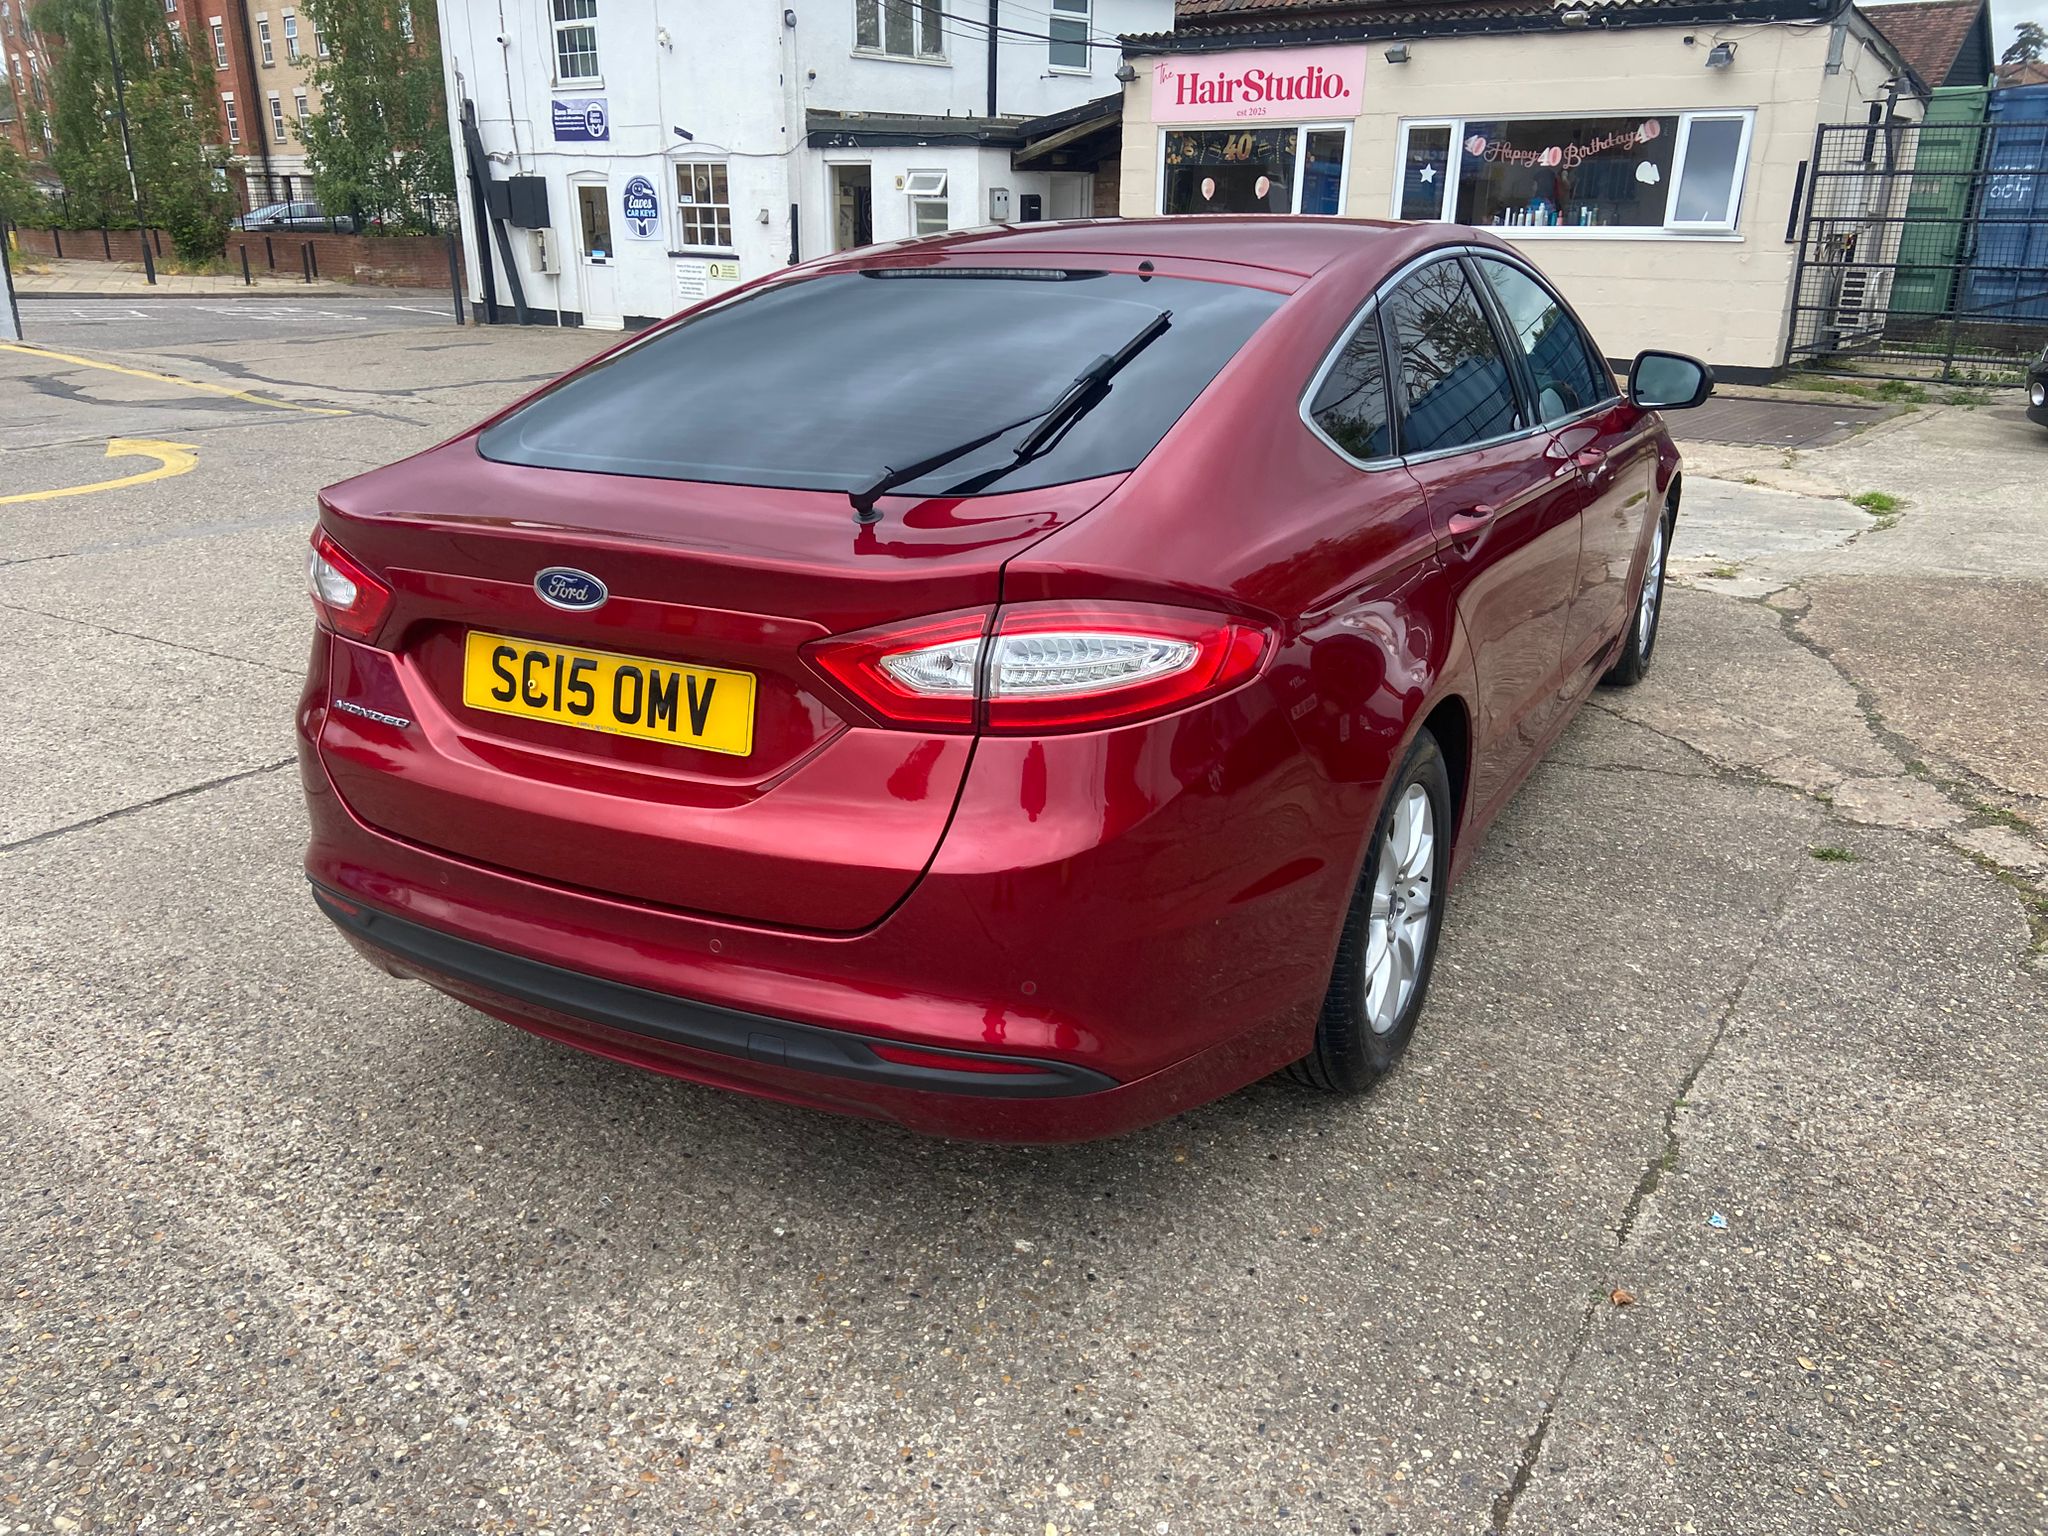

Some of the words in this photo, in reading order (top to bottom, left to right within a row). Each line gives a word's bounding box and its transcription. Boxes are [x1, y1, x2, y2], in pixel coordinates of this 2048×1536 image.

[1155, 62, 1175, 84] The
[1176, 66, 1350, 105] HairStudio.
[1248, 107, 1267, 117] 2025
[1222, 133, 1253, 160] 40
[1463, 134, 1486, 157] 40
[1483, 141, 1539, 168] Happy
[1537, 146, 1562, 167] 40
[1563, 130, 1637, 169] Birthday
[1635, 118, 1661, 144] 40
[626, 209, 639, 217] CAR
[640, 209, 657, 218] KEYS
[548, 574, 589, 601] Ford
[491, 645, 598, 717] SC15
[612, 665, 717, 737] OMV
